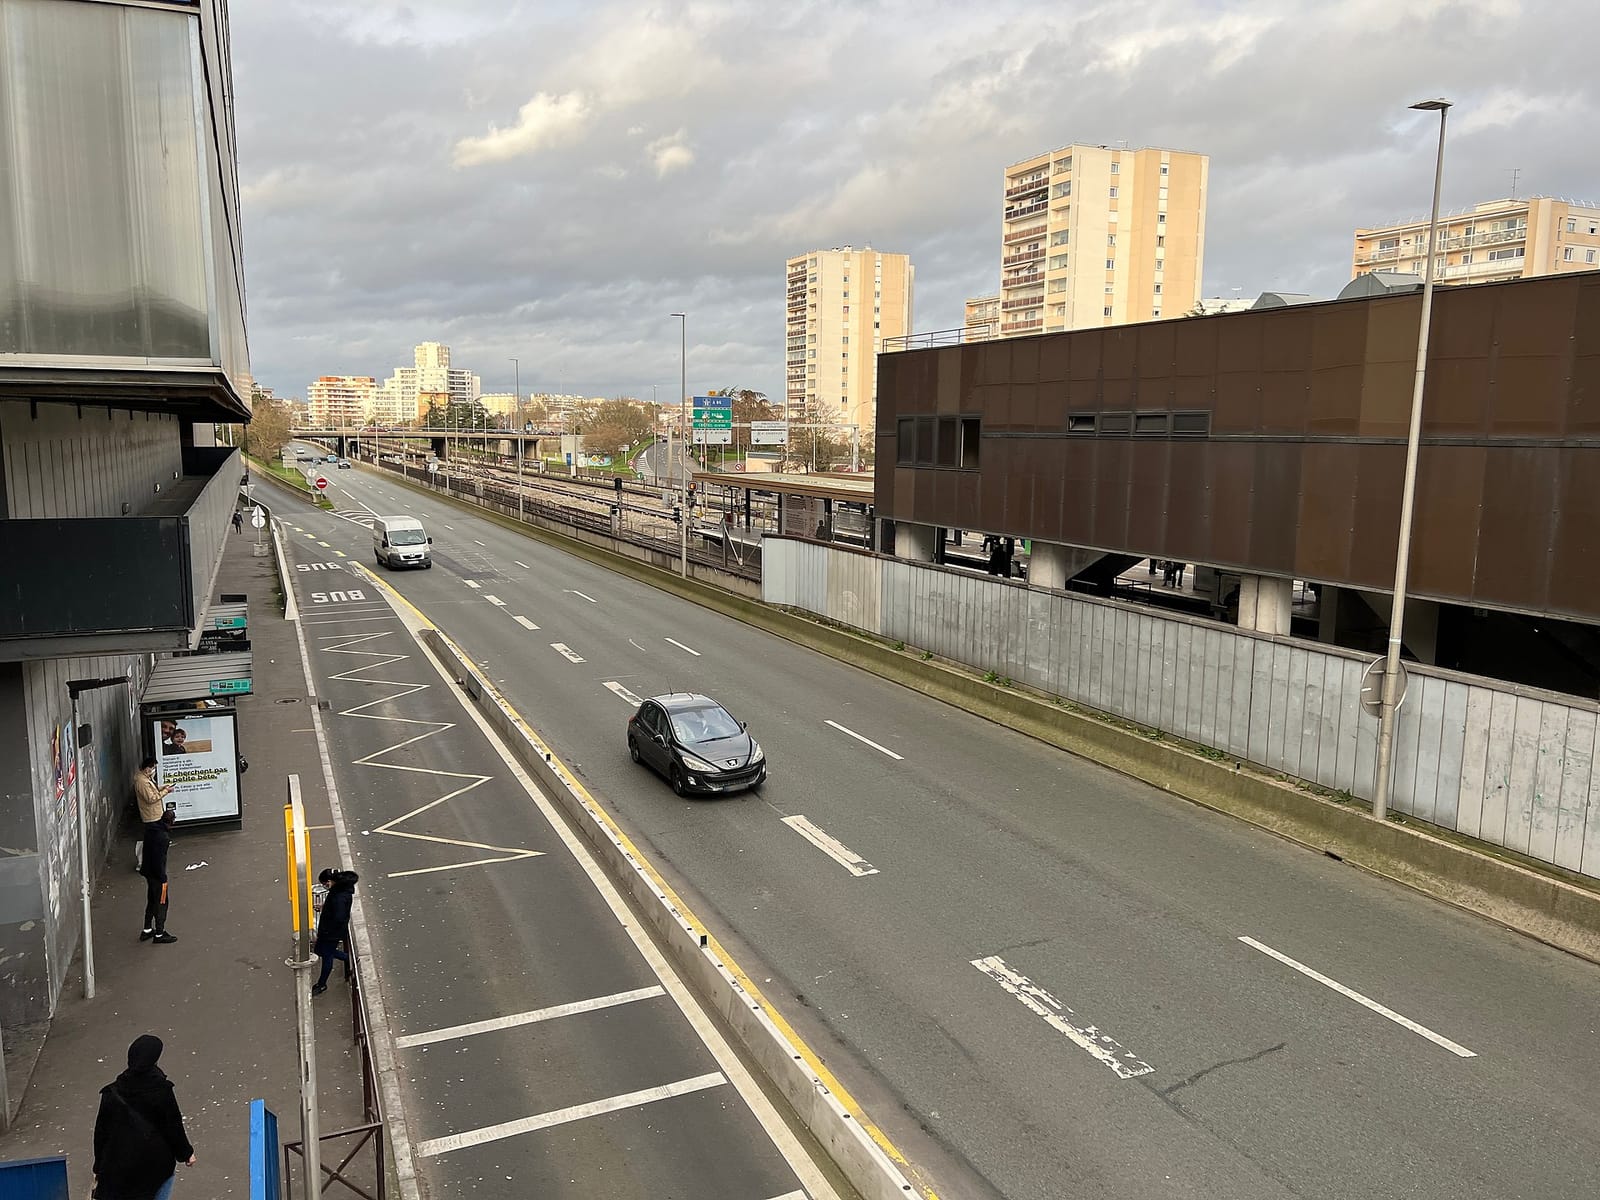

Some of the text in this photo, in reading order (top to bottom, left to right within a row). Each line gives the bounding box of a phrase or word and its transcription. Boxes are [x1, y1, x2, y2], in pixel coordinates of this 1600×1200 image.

[296, 562, 342, 572] BUS
[311, 590, 366, 603] BUS
[173, 768, 214, 777] cherchent
[172, 775, 196, 783] petite
